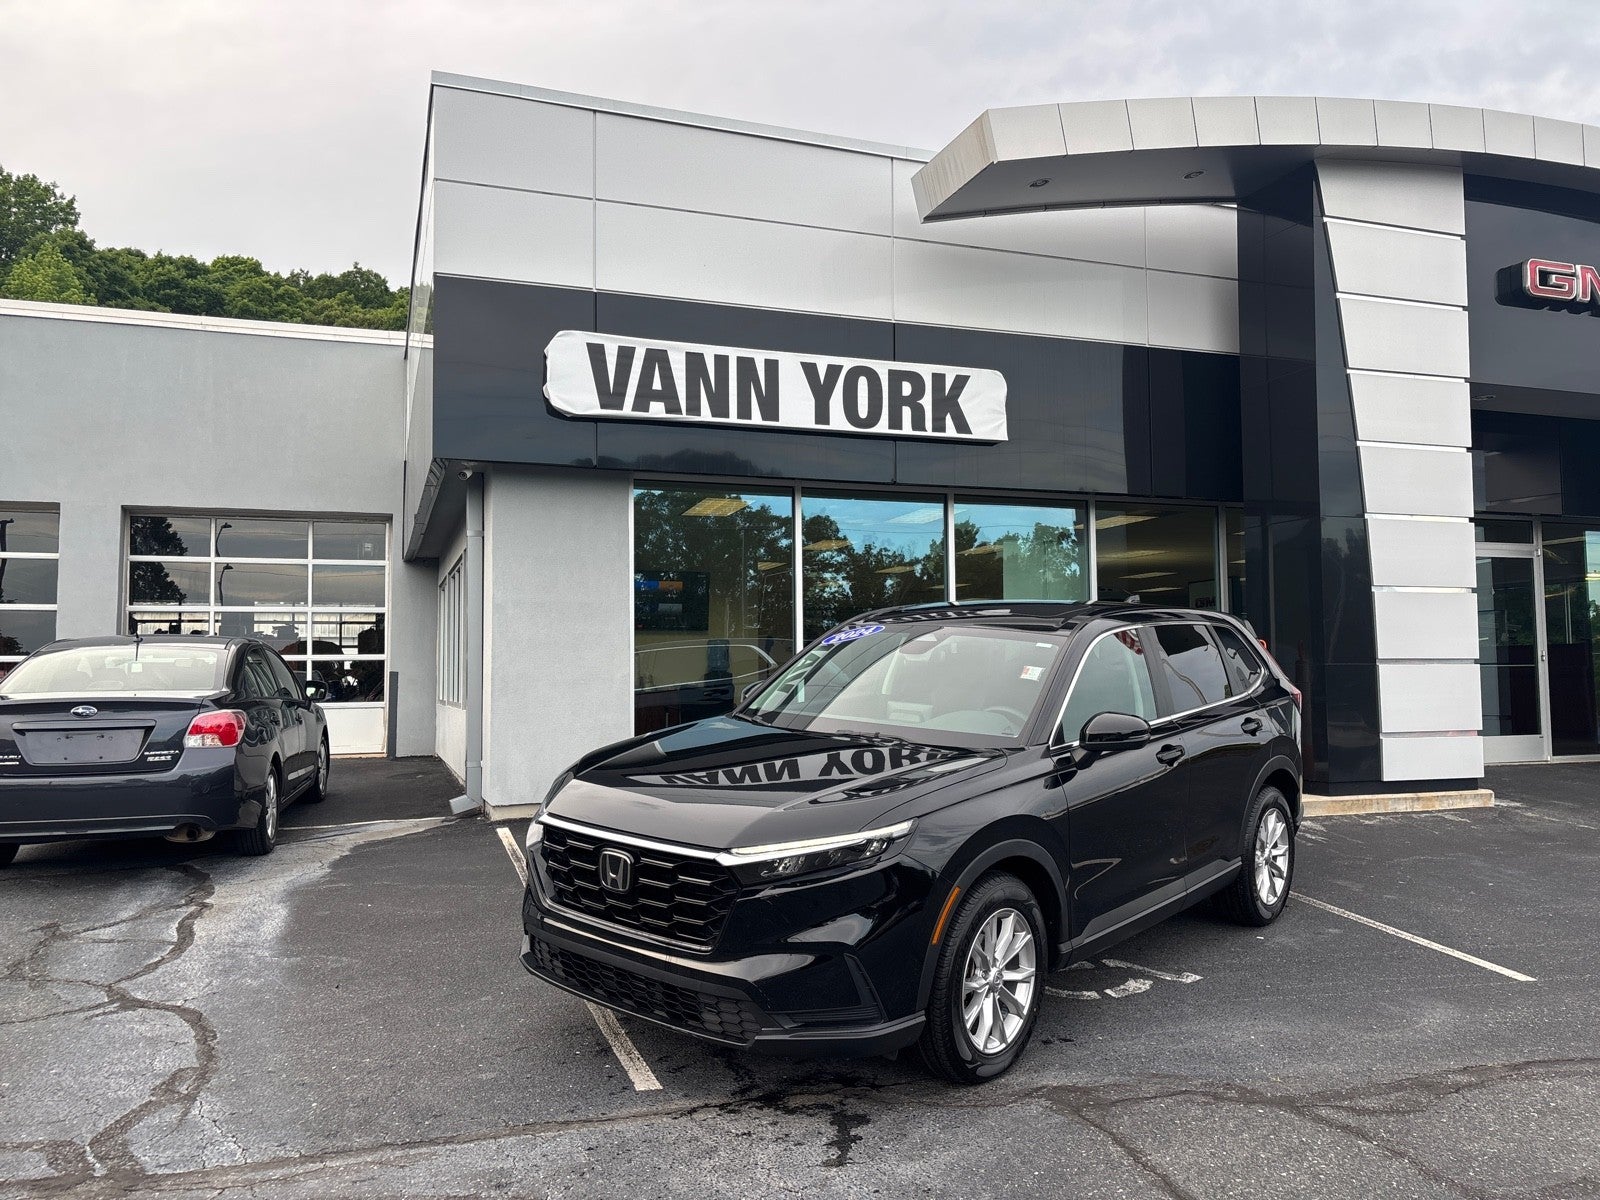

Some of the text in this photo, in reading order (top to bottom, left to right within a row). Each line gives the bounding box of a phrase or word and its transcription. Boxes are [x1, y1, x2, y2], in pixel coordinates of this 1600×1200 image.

[586, 342, 973, 435] VANN YORK
[834, 626, 873, 641] 2024
